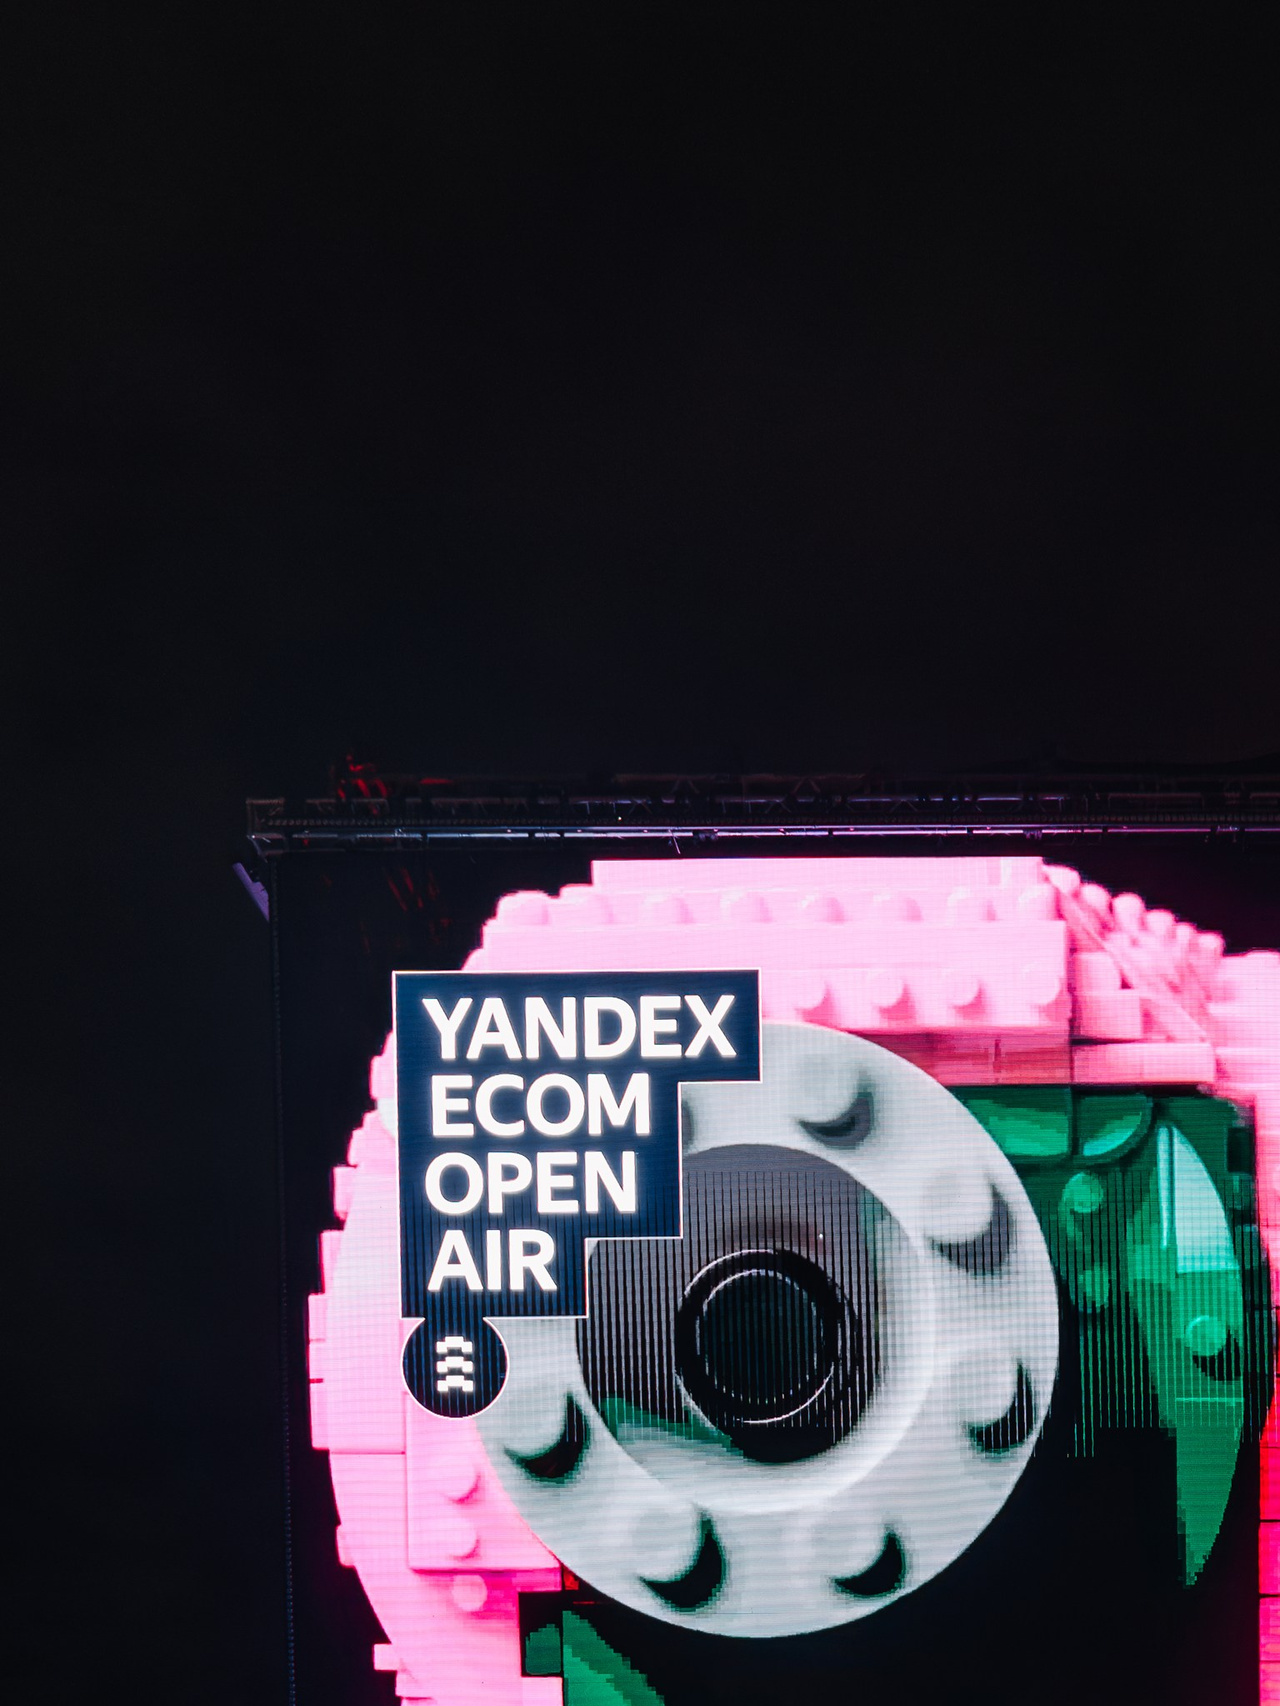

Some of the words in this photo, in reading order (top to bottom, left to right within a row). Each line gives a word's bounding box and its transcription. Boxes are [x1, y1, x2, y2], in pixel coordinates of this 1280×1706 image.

[422, 995, 736, 1060] YANDEX
[431, 1073, 650, 1137] ECOM
[425, 1151, 636, 1215] OPEN
[428, 1229, 557, 1292] AIR
